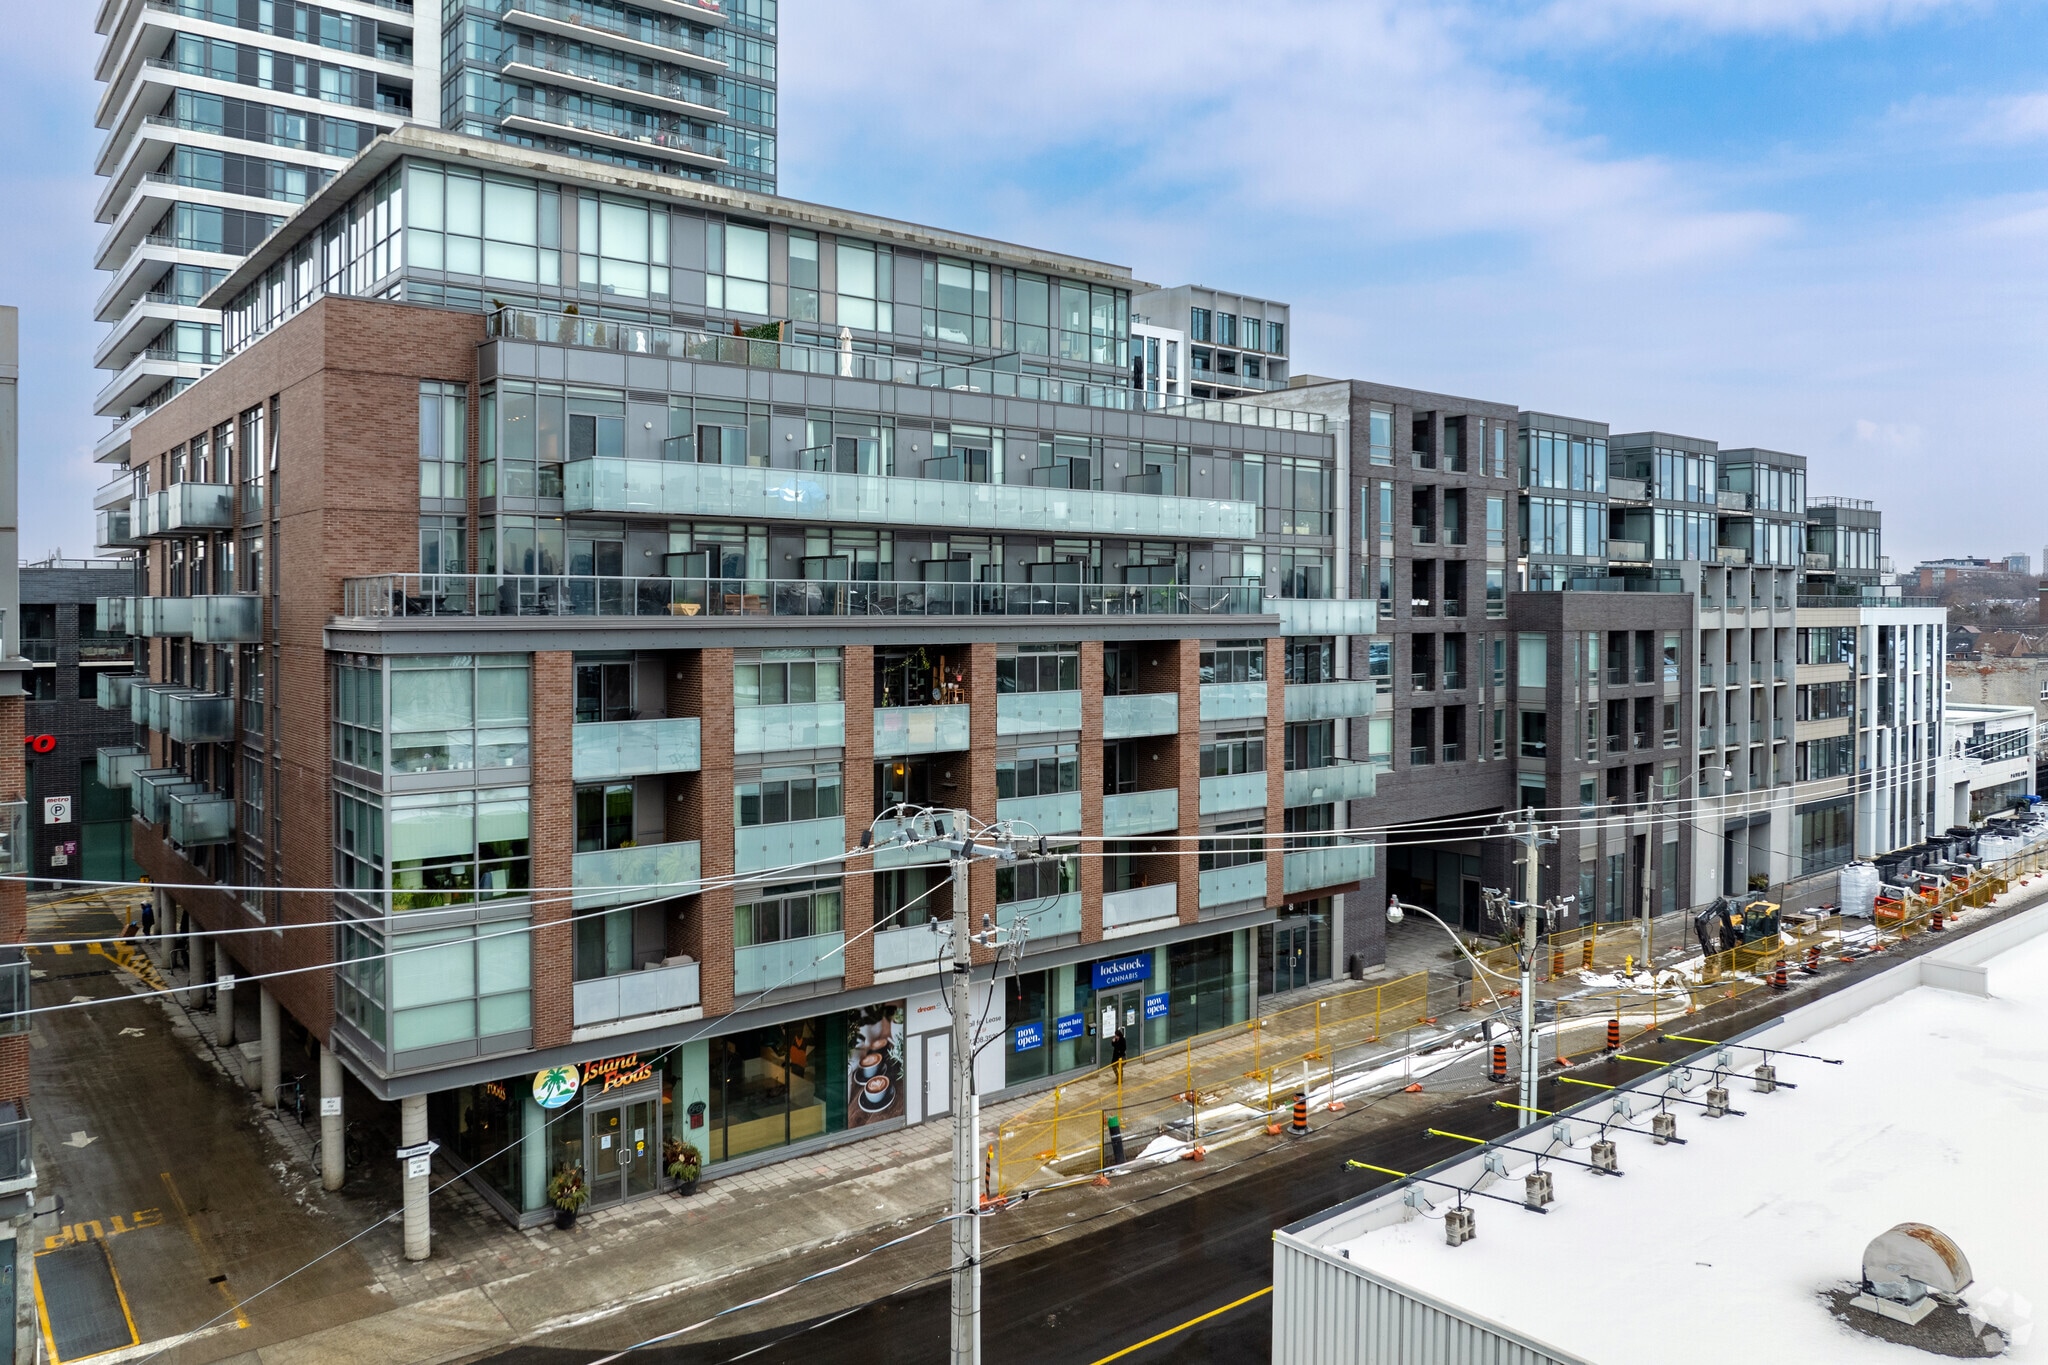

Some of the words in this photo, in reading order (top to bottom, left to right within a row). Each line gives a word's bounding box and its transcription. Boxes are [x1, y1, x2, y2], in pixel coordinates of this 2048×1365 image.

[1100, 958, 1145, 976] lockstock.
[1106, 971, 1138, 984] CANNABIS
[1147, 996, 1162, 1006] now
[917, 1005, 936, 1013] dream
[1147, 1003, 1167, 1015] open.
[985, 1015, 1002, 1024] Lease
[1058, 1020, 1072, 1030] open
[1071, 1018, 1082, 1026] late
[1017, 1027, 1035, 1038] now
[1017, 1034, 1041, 1048] open.
[581, 1052, 638, 1086] Island
[602, 1062, 652, 1094] Foods
